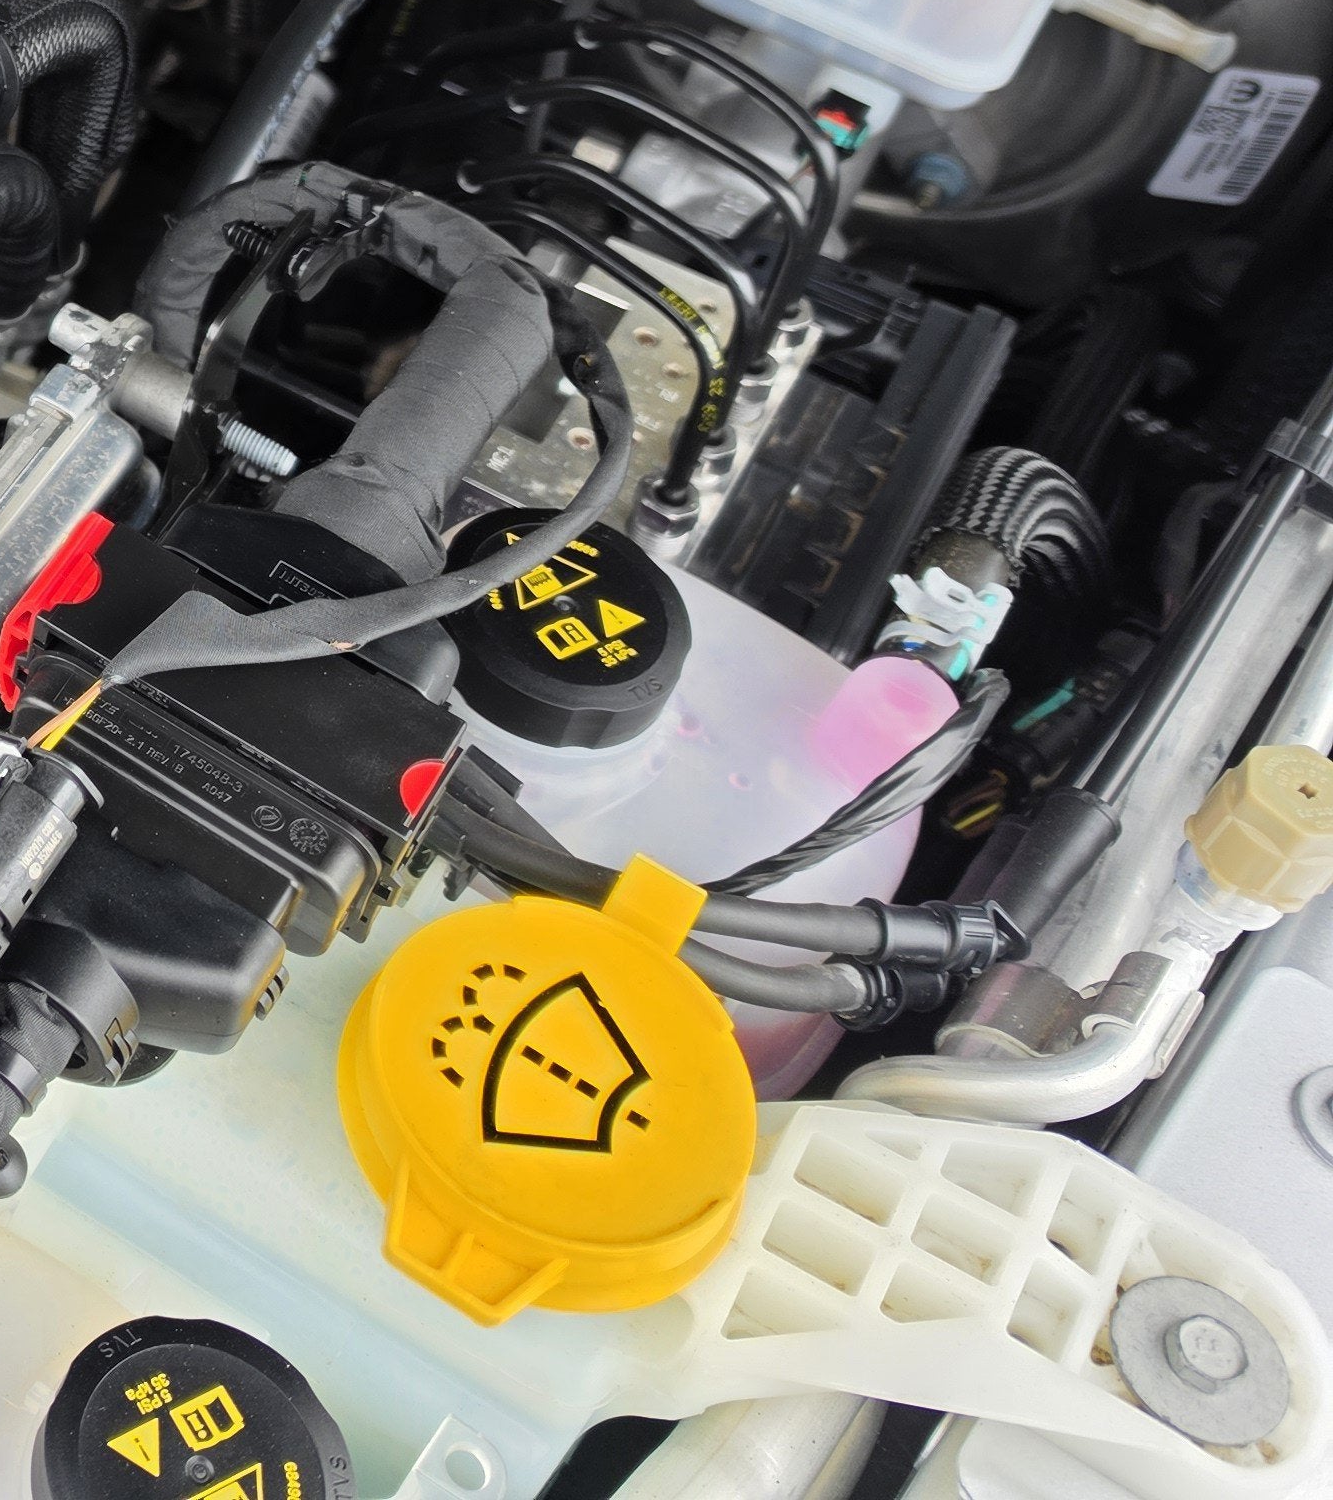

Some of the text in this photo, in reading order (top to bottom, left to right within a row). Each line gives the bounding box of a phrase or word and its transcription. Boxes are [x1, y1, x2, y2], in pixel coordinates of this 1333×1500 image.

[628, 678, 663, 700] TVS
[173, 744, 244, 793] 1745048-3
[202, 782, 233, 803] A047
[98, 1329, 143, 1358] TVS
[124, 1373, 170, 1401] 35 kPa
[136, 1388, 173, 1415] 5 PSI
